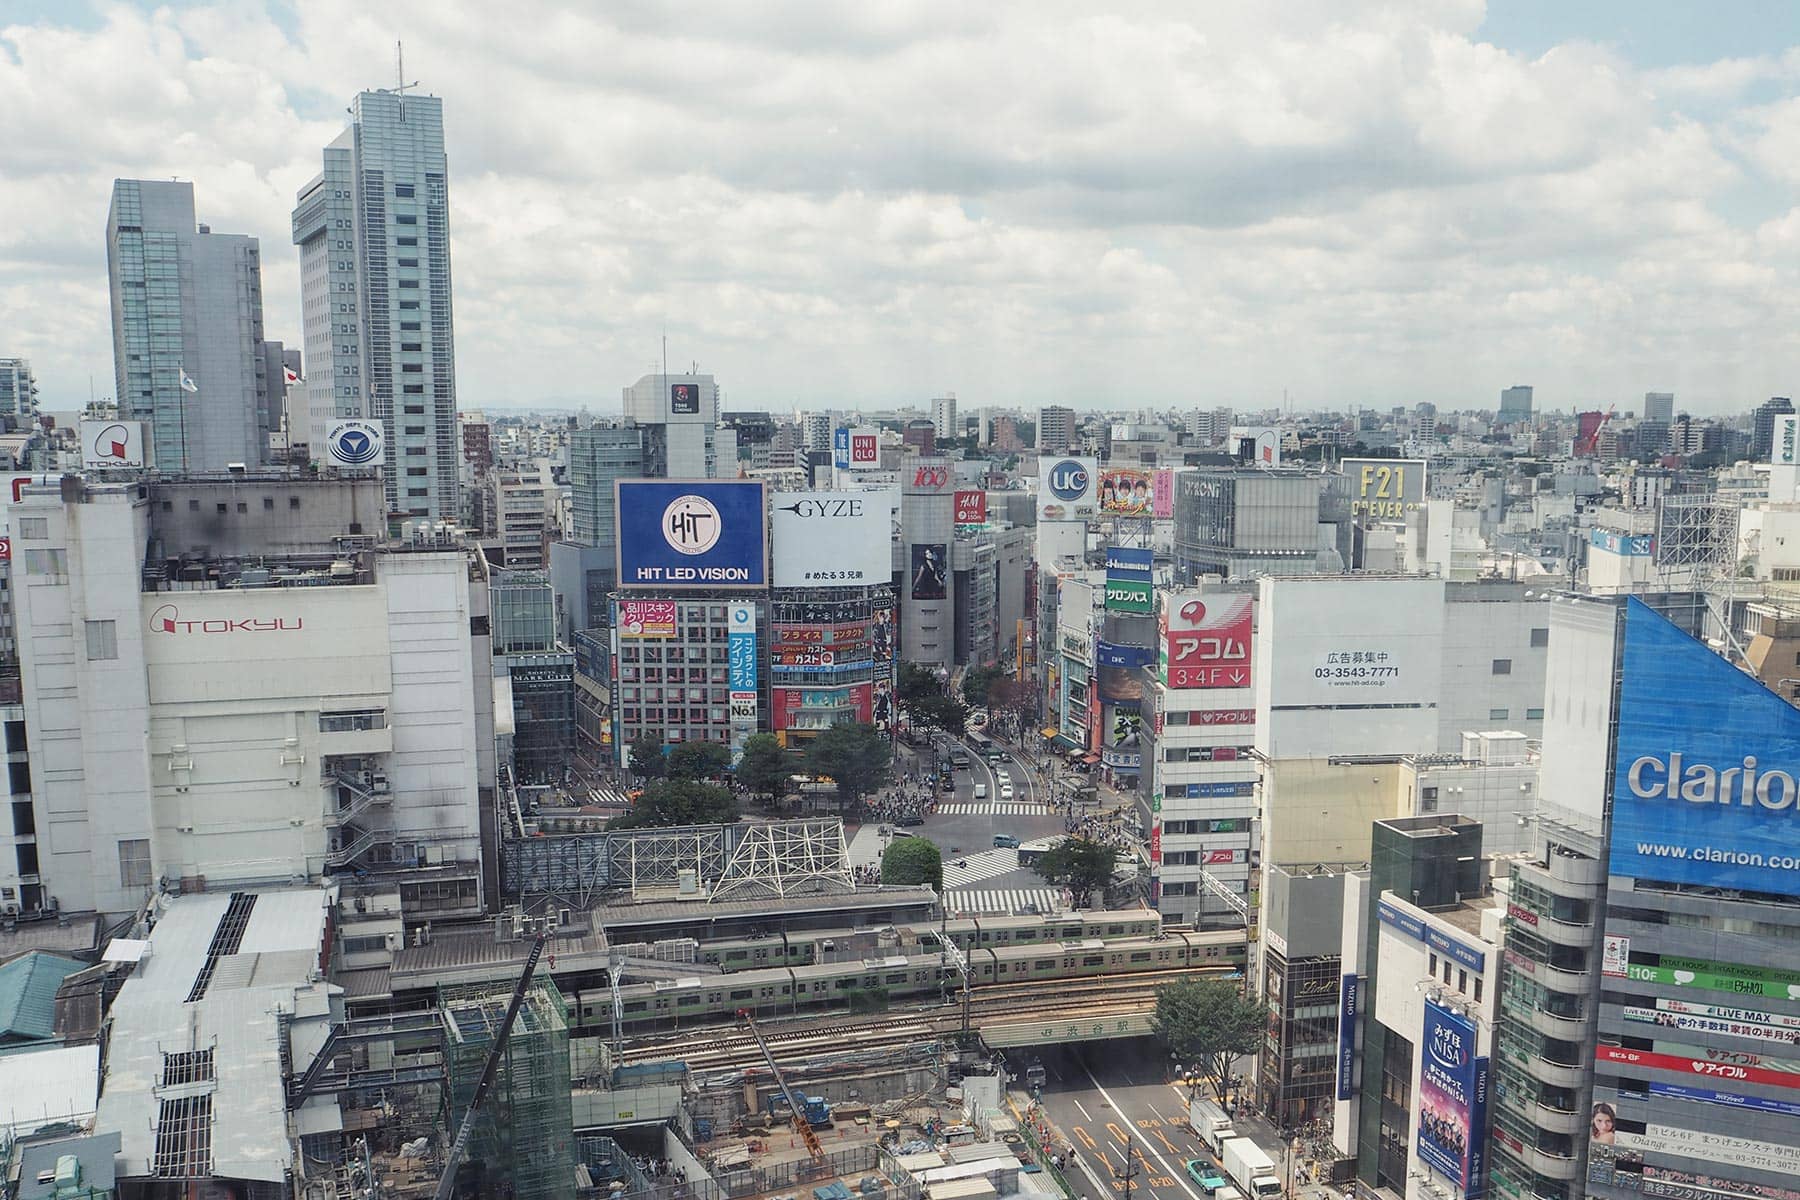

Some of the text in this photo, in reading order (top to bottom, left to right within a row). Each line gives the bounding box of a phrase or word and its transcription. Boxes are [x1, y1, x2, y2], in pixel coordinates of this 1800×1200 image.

[855, 439, 872, 448] UNI
[855, 449, 874, 460] QLO
[913, 470, 947, 492] 109
[1361, 466, 1404, 498] F21
[797, 500, 863, 517] GYZE
[960, 495, 979, 507] H&M
[637, 567, 749, 580] HIT LED VISION
[627, 602, 674, 613] 品川スキン
[177, 617, 302, 634] TOKYU
[627, 613, 674, 623] クリニック
[833, 628, 864, 640] コンタクト
[1175, 638, 1246, 661] アコム
[732, 637, 742, 687] アイシティ
[795, 654, 820, 664] ガスト
[1327, 652, 1388, 664] 広告募集中
[1315, 667, 1398, 678] 03-3543-7771
[1215, 713, 1248, 721] アイフル
[1628, 752, 1800, 811] Clario
[1347, 985, 1356, 1016] MIZUHO
[1744, 1012, 1771, 1023] MAX
[1434, 1023, 1461, 1048] みずほ
[1434, 1036, 1460, 1064] NISA
[1719, 1050, 1761, 1065] アイフル
[1706, 1062, 1747, 1078] アイフル
[1478, 1070, 1487, 1103] MIZUHO
